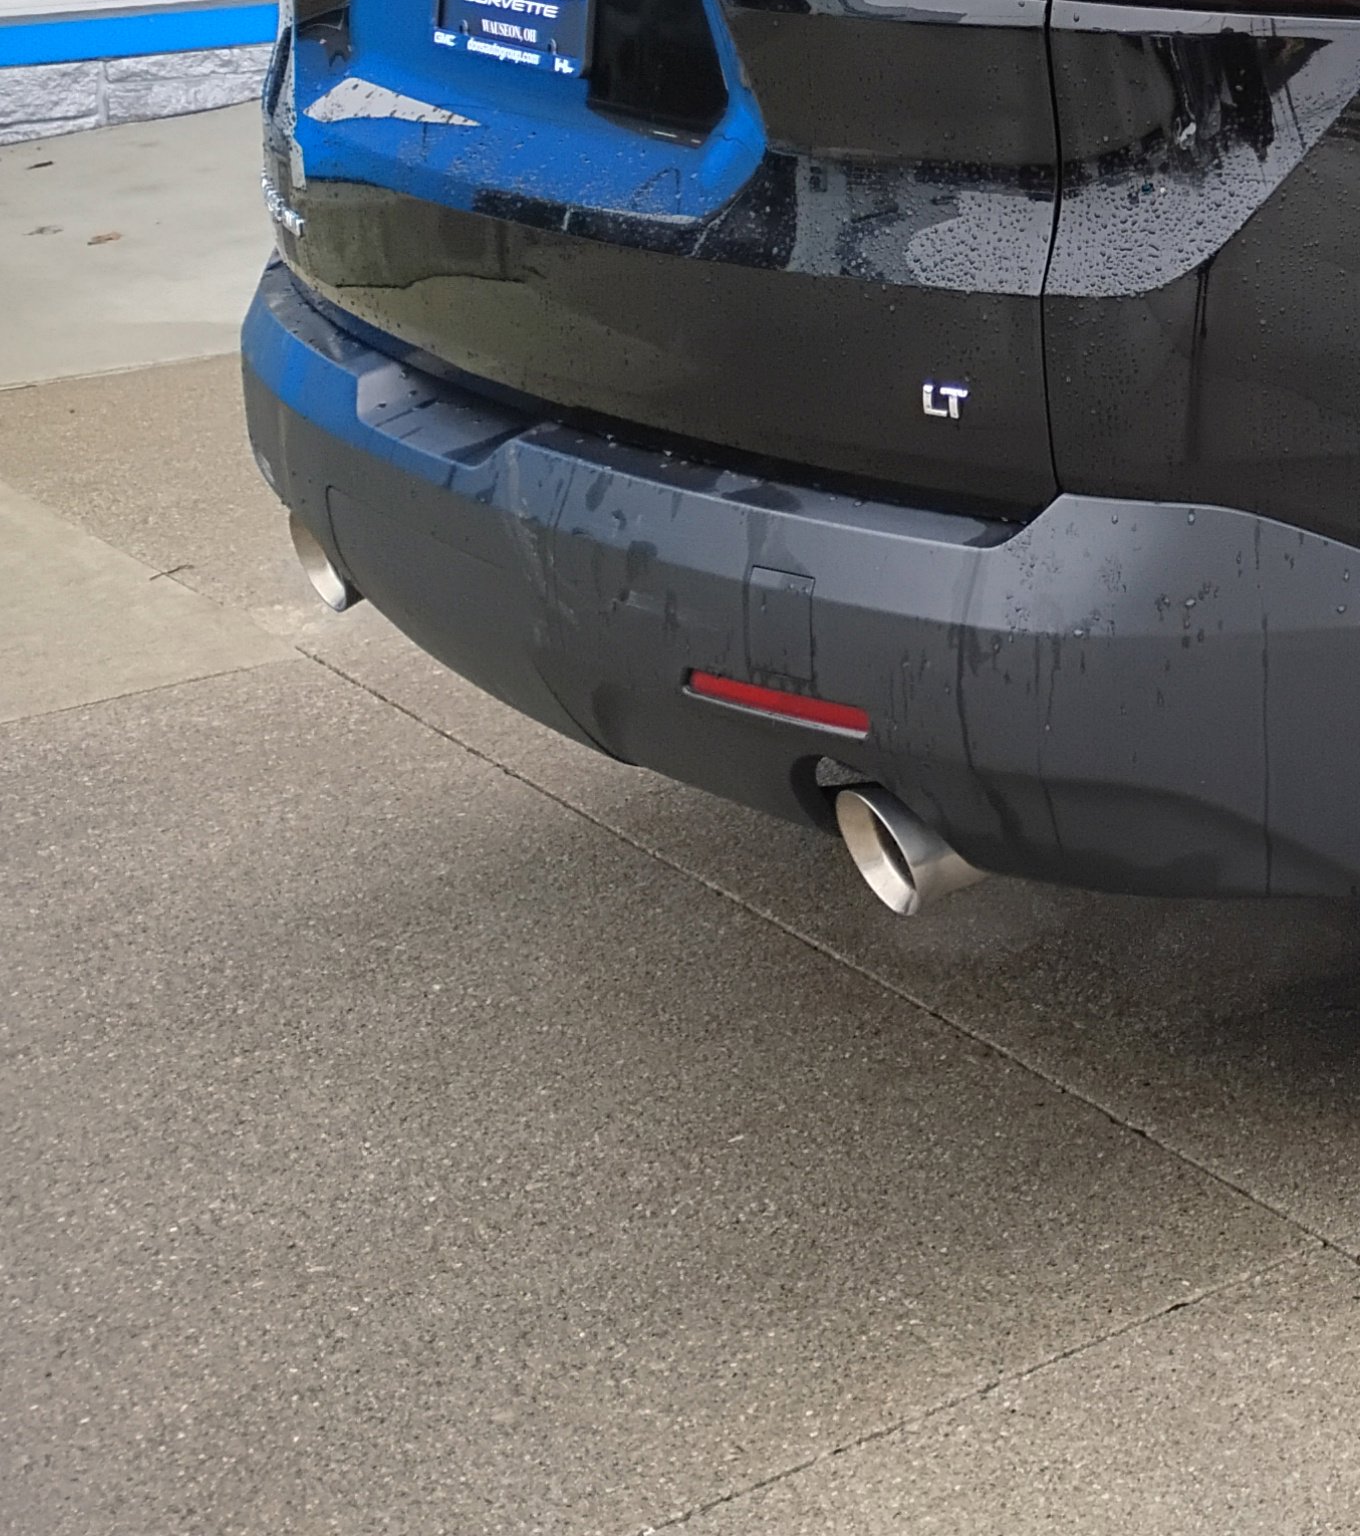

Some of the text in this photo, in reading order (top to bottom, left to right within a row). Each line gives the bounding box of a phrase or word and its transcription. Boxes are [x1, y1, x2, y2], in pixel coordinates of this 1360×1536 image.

[481, 18, 537, 43] WAUSEON, OH
[922, 384, 968, 419] LT
